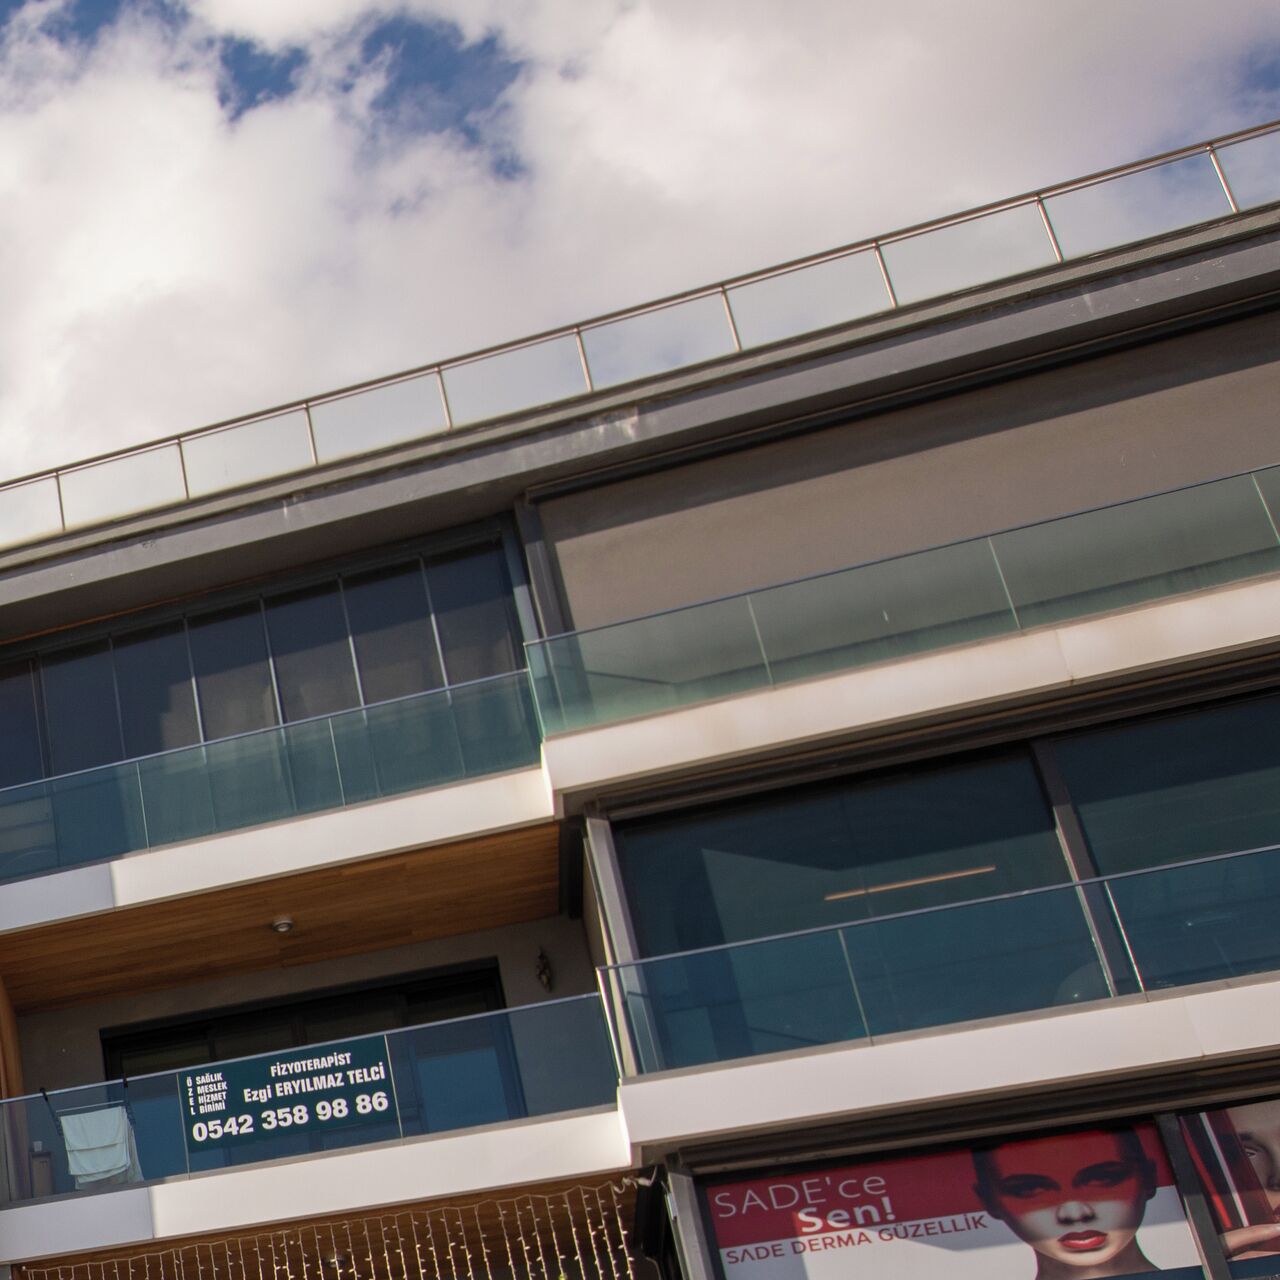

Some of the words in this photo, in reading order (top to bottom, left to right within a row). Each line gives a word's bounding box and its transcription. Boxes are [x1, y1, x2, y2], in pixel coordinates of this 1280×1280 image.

[195, 1072, 223, 1086] SAĞLIK
[270, 1052, 352, 1077] FİZYOTERAPİST
[197, 1081, 228, 1095] MESLEK
[198, 1091, 228, 1105] HİZMET
[243, 1084, 272, 1103] Ezgi
[275, 1073, 344, 1097] ERYILMAZ
[346, 1062, 385, 1085] TELCİ
[192, 1114, 254, 1142] 0542
[261, 1104, 310, 1130] 358
[315, 1098, 349, 1121] 98
[355, 1091, 389, 1115] 86
[199, 1102, 227, 1115] BİRİMİ
[715, 1175, 886, 1218] SADE'ce
[797, 1196, 896, 1233] Sen!
[726, 1246, 786, 1265] SADE
[792, 1231, 872, 1256] DERMA
[878, 1214, 989, 1242] GÜZELLİK
